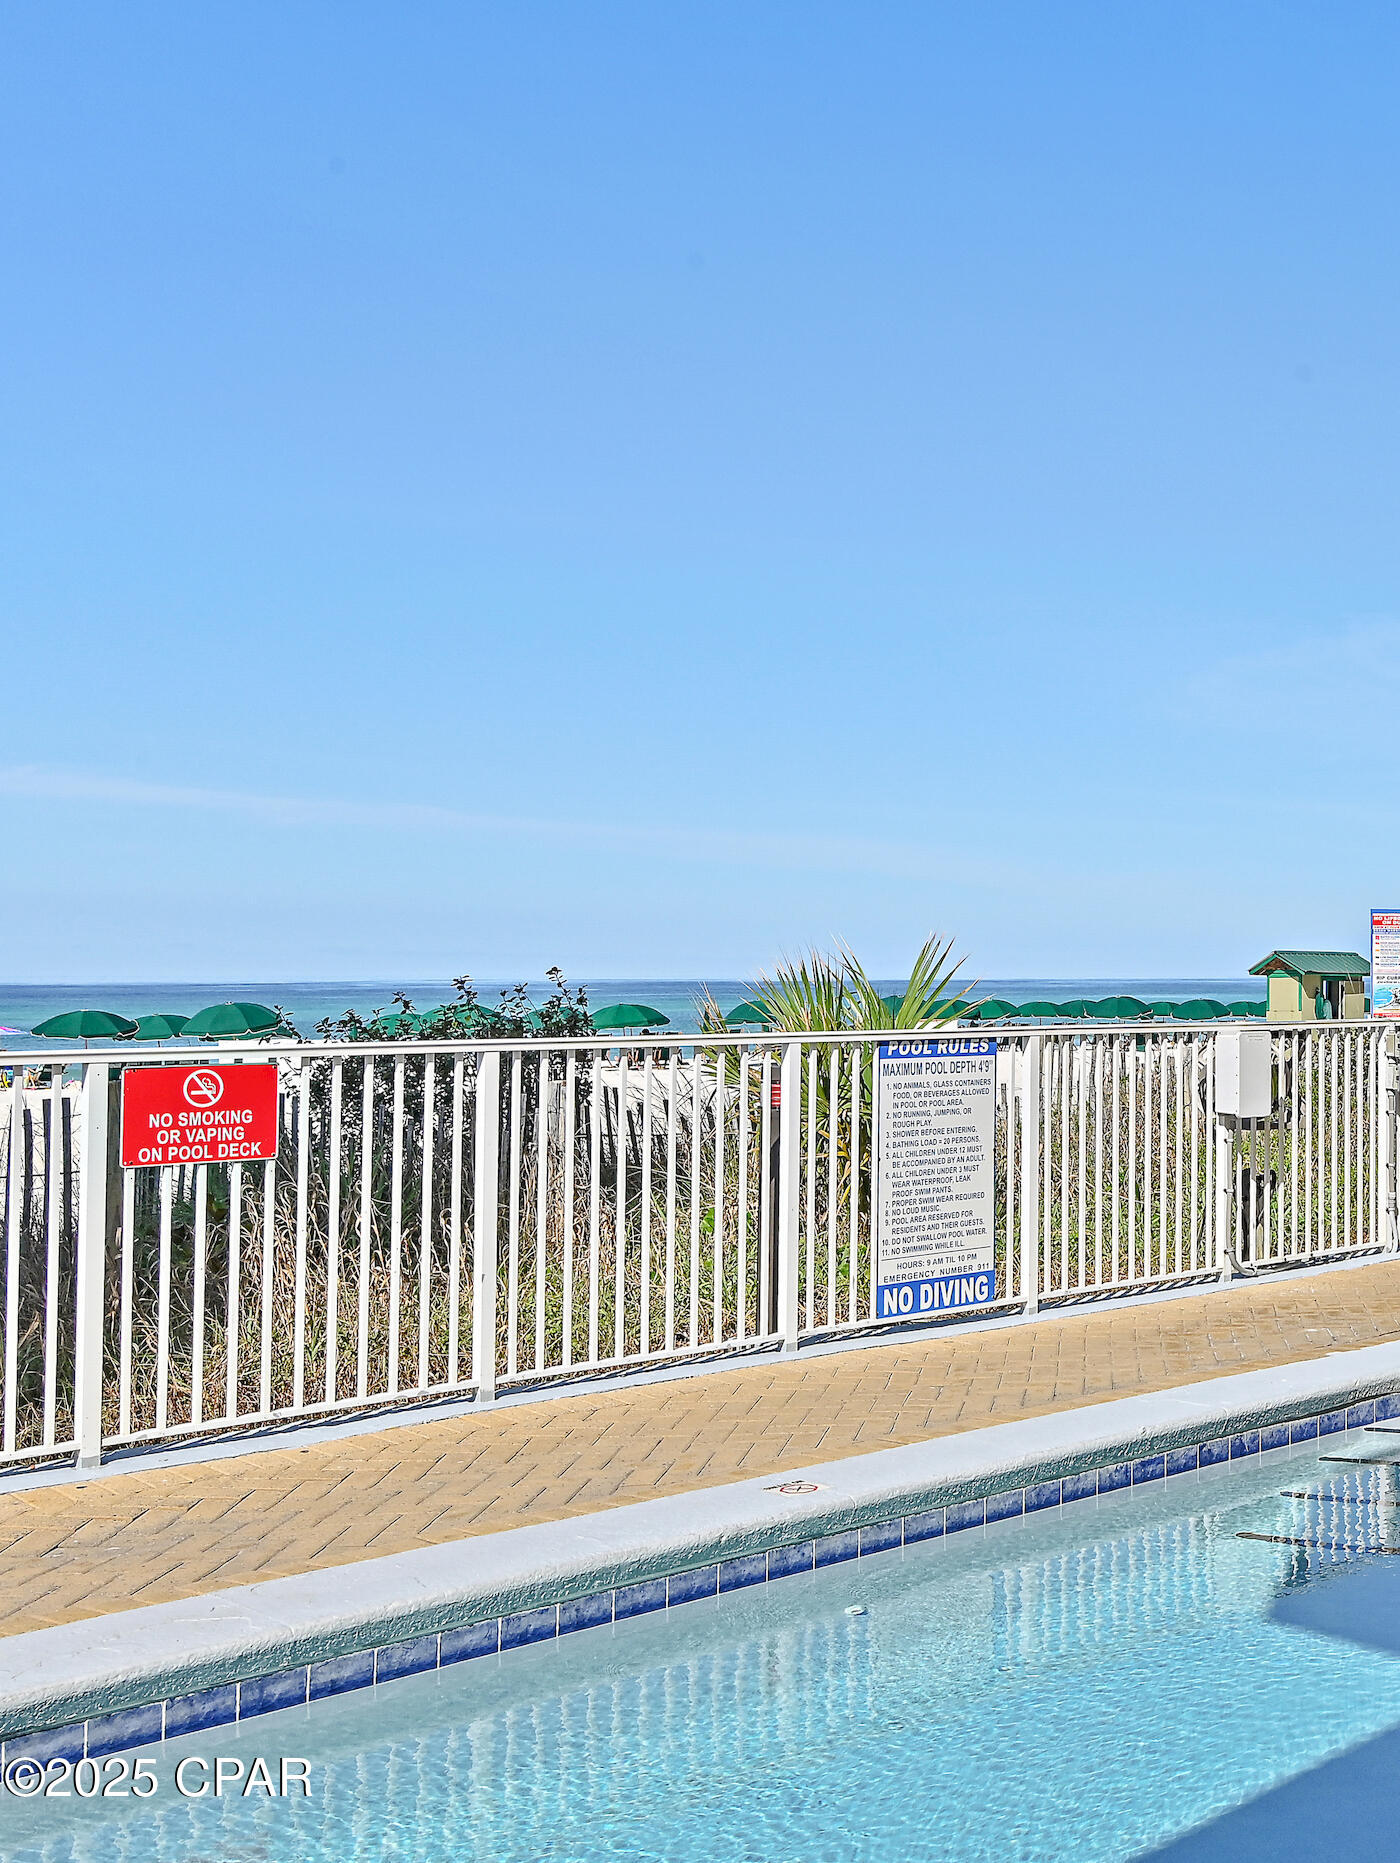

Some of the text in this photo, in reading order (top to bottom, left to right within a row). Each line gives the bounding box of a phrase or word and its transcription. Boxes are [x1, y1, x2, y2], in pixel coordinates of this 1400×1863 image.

[888, 1038, 989, 1056] POOL RULES
[882, 1062, 922, 1076] MAXIMUM
[925, 1061, 947, 1074] POOL
[949, 1060, 976, 1074] DEPTH
[923, 1089, 960, 1098] BEVERAGES
[960, 1087, 989, 1096] ALLOWED
[149, 1110, 253, 1128] NO SMOKING
[892, 1120, 914, 1128] ROUGH
[157, 1126, 245, 1144] OR VAPING
[892, 1129, 919, 1138] SHOWER
[920, 1127, 945, 1136] BEFORE
[946, 1125, 977, 1134] ENTERING.
[892, 1139, 919, 1148] BATHING
[920, 1138, 937, 1146] LOAD
[138, 1142, 262, 1163] ON POOL DECK
[904, 1148, 935, 1158] CHILDREN
[936, 1147, 957, 1155] UNDER
[901, 1157, 945, 1168] ACCOMPANIED
[891, 1170, 903, 1179] ALL
[904, 1168, 935, 1178] CHILDREN
[936, 1166, 957, 1175] UNDER
[963, 1164, 979, 1172] MUST
[891, 1180, 910, 1188] WEAR
[955, 1174, 970, 1182] LEAK
[891, 1198, 917, 1207] PROPER
[918, 1196, 934, 1204] SWIM
[935, 1194, 953, 1203] WEAR
[954, 1191, 984, 1201] REQUIRED
[892, 1189, 912, 1198] PROOF
[914, 1187, 930, 1196] SWIM
[891, 1216, 908, 1225] POOL
[910, 1214, 926, 1223] AREA
[927, 1211, 959, 1221] RESERVED
[960, 1209, 973, 1218] FOR
[902, 1206, 919, 1215] LOUD
[891, 1224, 925, 1235] RESIDENTS
[926, 1223, 939, 1231] AND
[941, 1221, 958, 1229] THEIR
[891, 1237, 900, 1245] DO
[902, 1235, 914, 1244] NOT
[916, 1232, 947, 1242] SWALLOW
[948, 1230, 964, 1238] POOL
[901, 1243, 933, 1254] SWIMMING
[934, 1241, 953, 1250] WHILE
[896, 1259, 924, 1270] HOURS:
[932, 1257, 943, 1265] AM
[945, 1256, 955, 1264] TIL
[966, 1253, 976, 1261] PM
[883, 1262, 988, 1283] EMERGENCY NUMBER 911
[883, 1275, 989, 1315] NO DIVING
